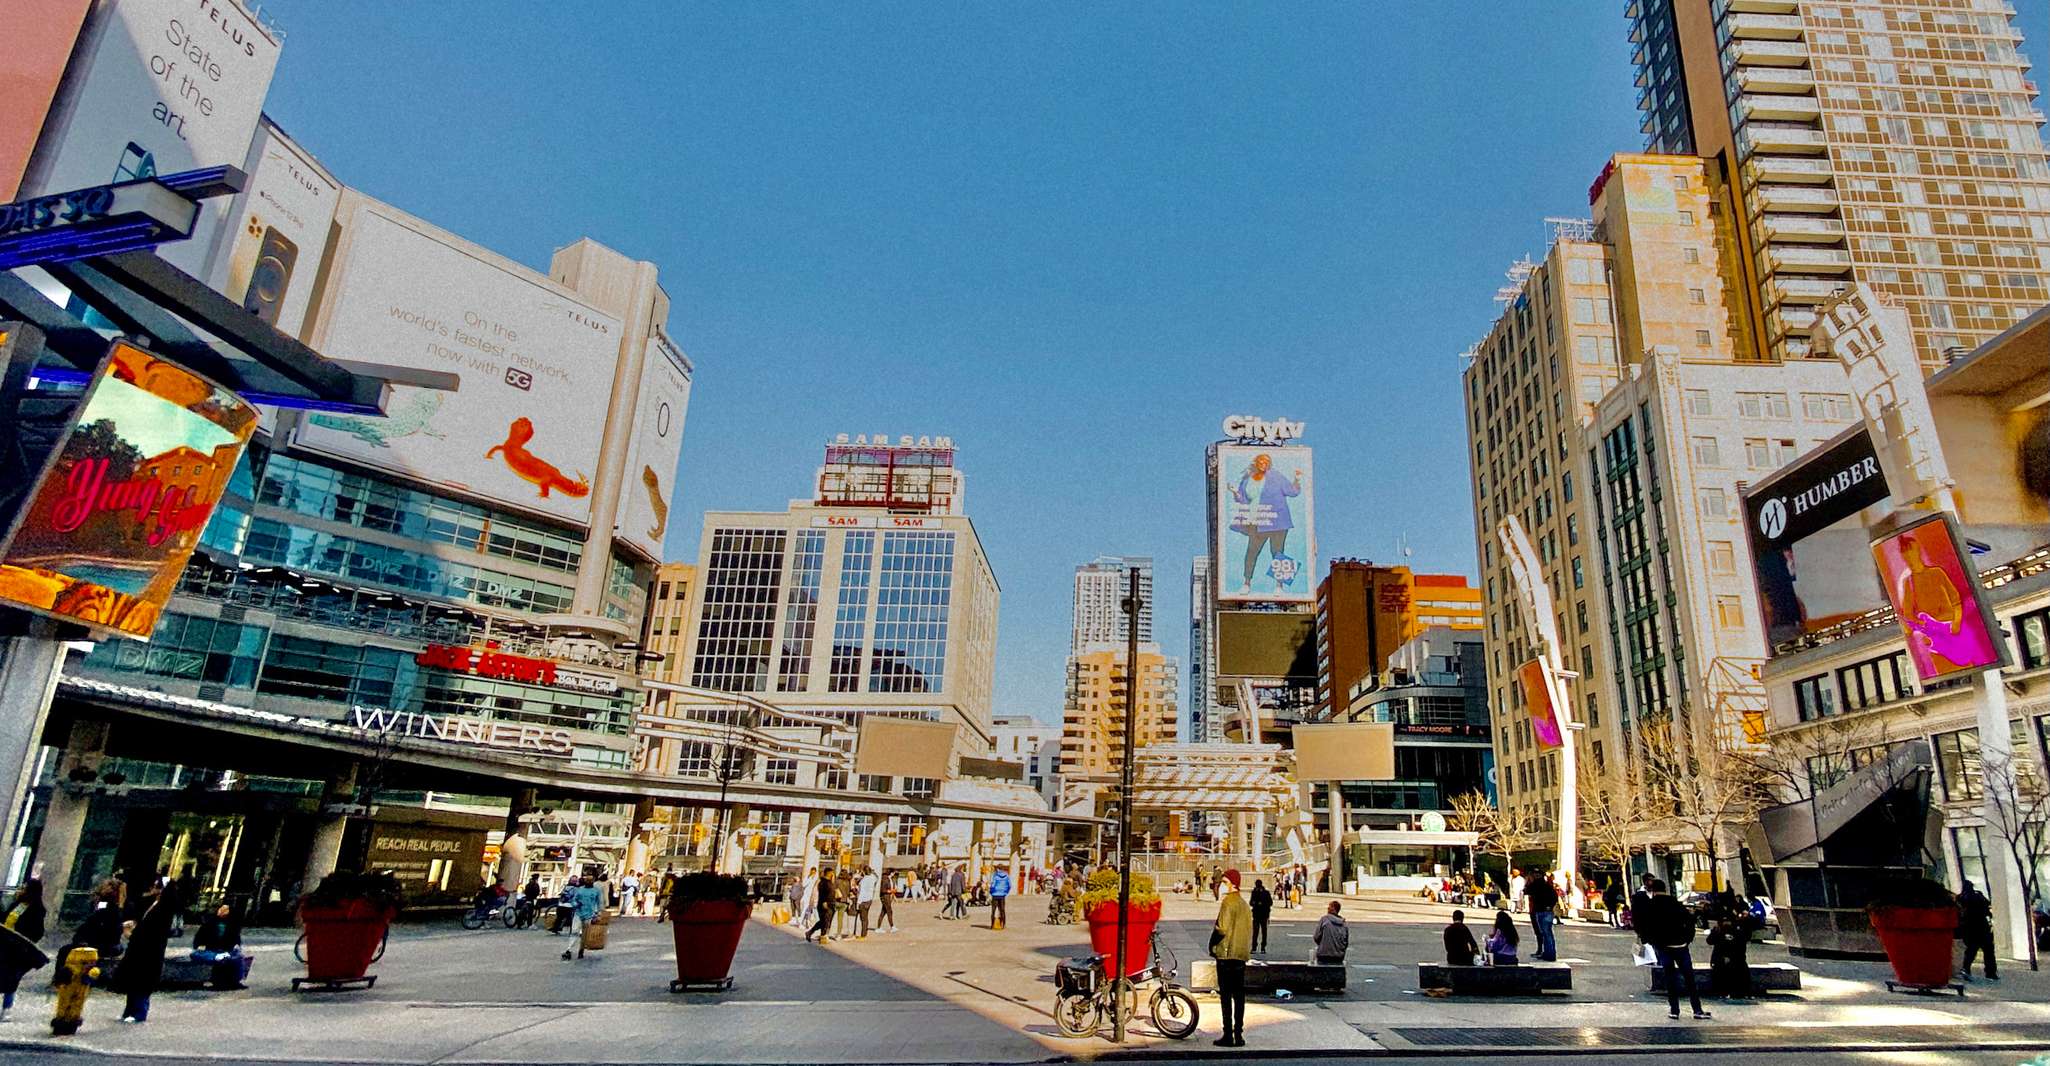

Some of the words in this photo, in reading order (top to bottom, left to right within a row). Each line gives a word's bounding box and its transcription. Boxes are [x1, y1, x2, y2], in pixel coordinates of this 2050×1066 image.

[199, 0, 256, 56] TELUS
[166, 19, 222, 82] State
[150, 54, 176, 78] of
[181, 75, 214, 117] the
[152, 101, 187, 141] art.
[288, 164, 320, 196] TELUS
[464, 310, 488, 329] On
[493, 316, 518, 342] the
[566, 309, 609, 334] TELUS
[388, 304, 449, 338] world's
[455, 327, 506, 357] fastest
[510, 343, 573, 384] network.
[427, 342, 463, 365] now
[468, 355, 500, 377] with
[507, 370, 532, 390] 5G
[836, 433, 888, 445] SAM
[900, 435, 952, 447] SAM
[1222, 415, 1305, 444] Citytv
[1793, 456, 1878, 515] HUMBER
[828, 517, 858, 526] SAM
[894, 518, 923, 527] SAM
[361, 557, 403, 576] DMZ
[427, 570, 465, 588] DMZ
[487, 582, 523, 600] DMZ
[354, 705, 574, 753] WINNERS
[376, 838, 406, 850] REACH
[407, 839, 428, 851] REAL
[430, 841, 463, 853] PEOPLE
